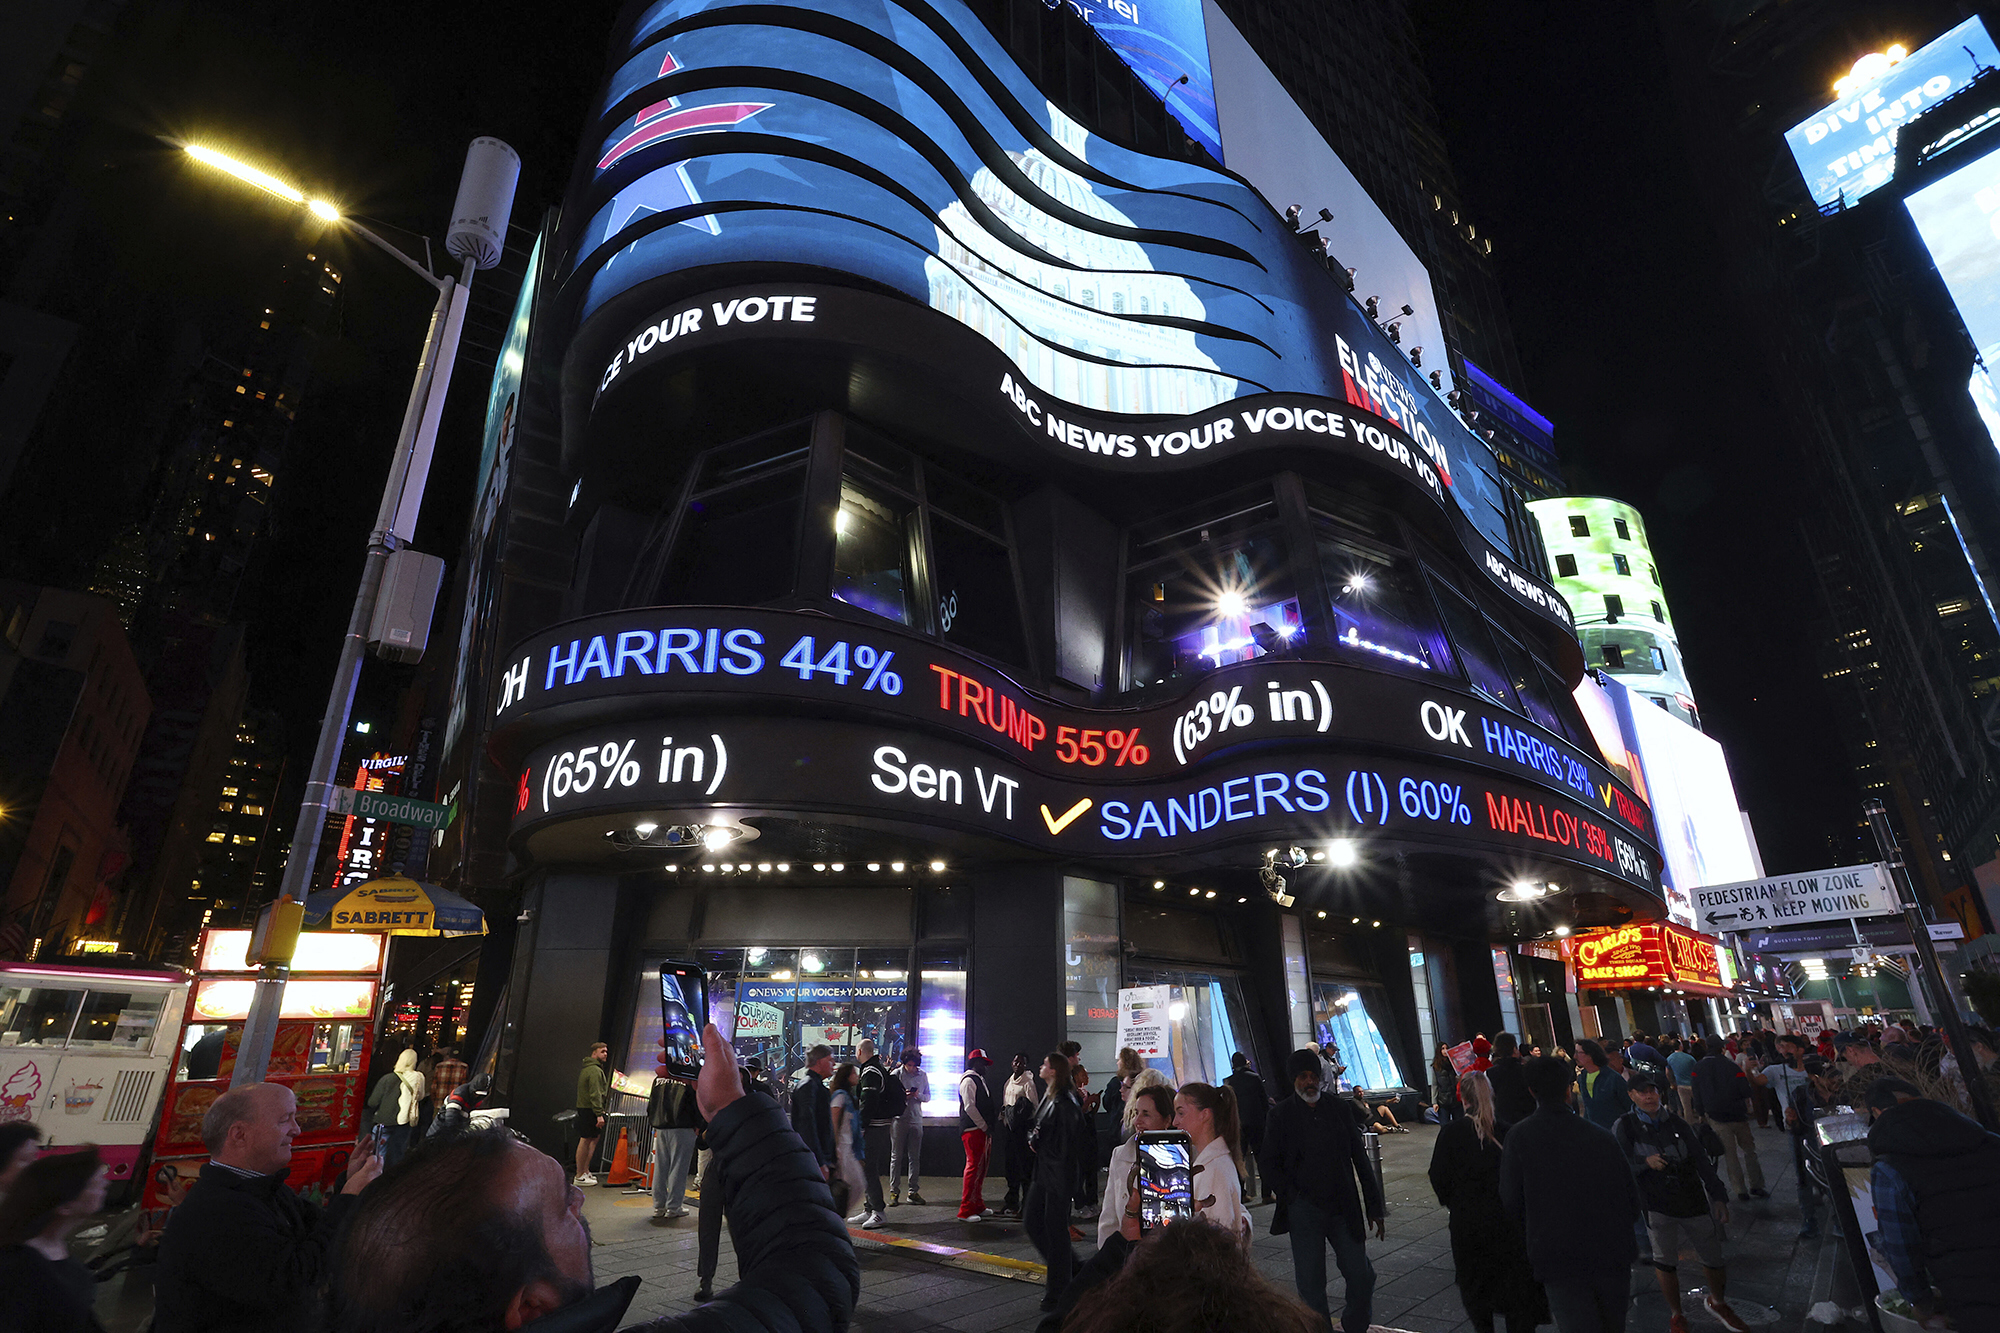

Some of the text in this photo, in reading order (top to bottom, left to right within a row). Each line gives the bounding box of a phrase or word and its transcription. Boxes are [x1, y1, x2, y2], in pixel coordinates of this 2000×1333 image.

[1804, 88, 1886, 145] DIVE
[1865, 75, 1951, 135] INTO
[627, 307, 703, 364] YOUR
[712, 296, 817, 327] VOTE
[1335, 333, 1450, 476] ELECTION
[1376, 357, 1418, 415] NEWS
[1000, 373, 1041, 426] ABC
[1046, 412, 1137, 458] NEWS
[1142, 418, 1235, 457] YOUR
[1241, 407, 1346, 438] VOICE
[1349, 418, 1412, 469] YOUR
[1486, 550, 1571, 627] ABC NEWS YOUR
[544, 628, 766, 691] HARRIS
[780, 635, 903, 696] 44%
[929, 663, 1046, 752] TRUMP
[1056, 726, 1150, 767] 55%
[1172, 684, 1255, 765] (63%
[1268, 680, 1333, 733] in)
[542, 738, 641, 812] (65%
[658, 734, 728, 795] in)
[1420, 700, 1473, 748] OK
[1481, 716, 1563, 782] HARRIS
[1563, 754, 1596, 799] 29%
[359, 795, 444, 829] Broadway
[871, 745, 963, 806] Sen
[974, 766, 1019, 821] VT
[1100, 769, 1331, 841] SANDERS
[1346, 770, 1390, 825] (I)
[1399, 777, 1473, 826] 60%
[1485, 791, 1580, 850] MALLOY
[1581, 820, 1614, 863] 35%
[335, 911, 429, 925] SABRETT
[357, 887, 418, 898] SABRETT
[1699, 873, 1863, 907] PEDESTRIAN FLOW ZONE
[1773, 894, 1870, 918] KEEP MOVING
[1579, 927, 1642, 966] CARLO'S
[1582, 965, 1648, 979] BAKE SHOP
[756, 988, 784, 998] NEWS
[785, 988, 810, 998] YOUR
[811, 988, 840, 998] VOICE
[847, 988, 872, 997] YOUR
[872, 987, 897, 997] VOTE
[340, 1077, 356, 1129] HALAL
